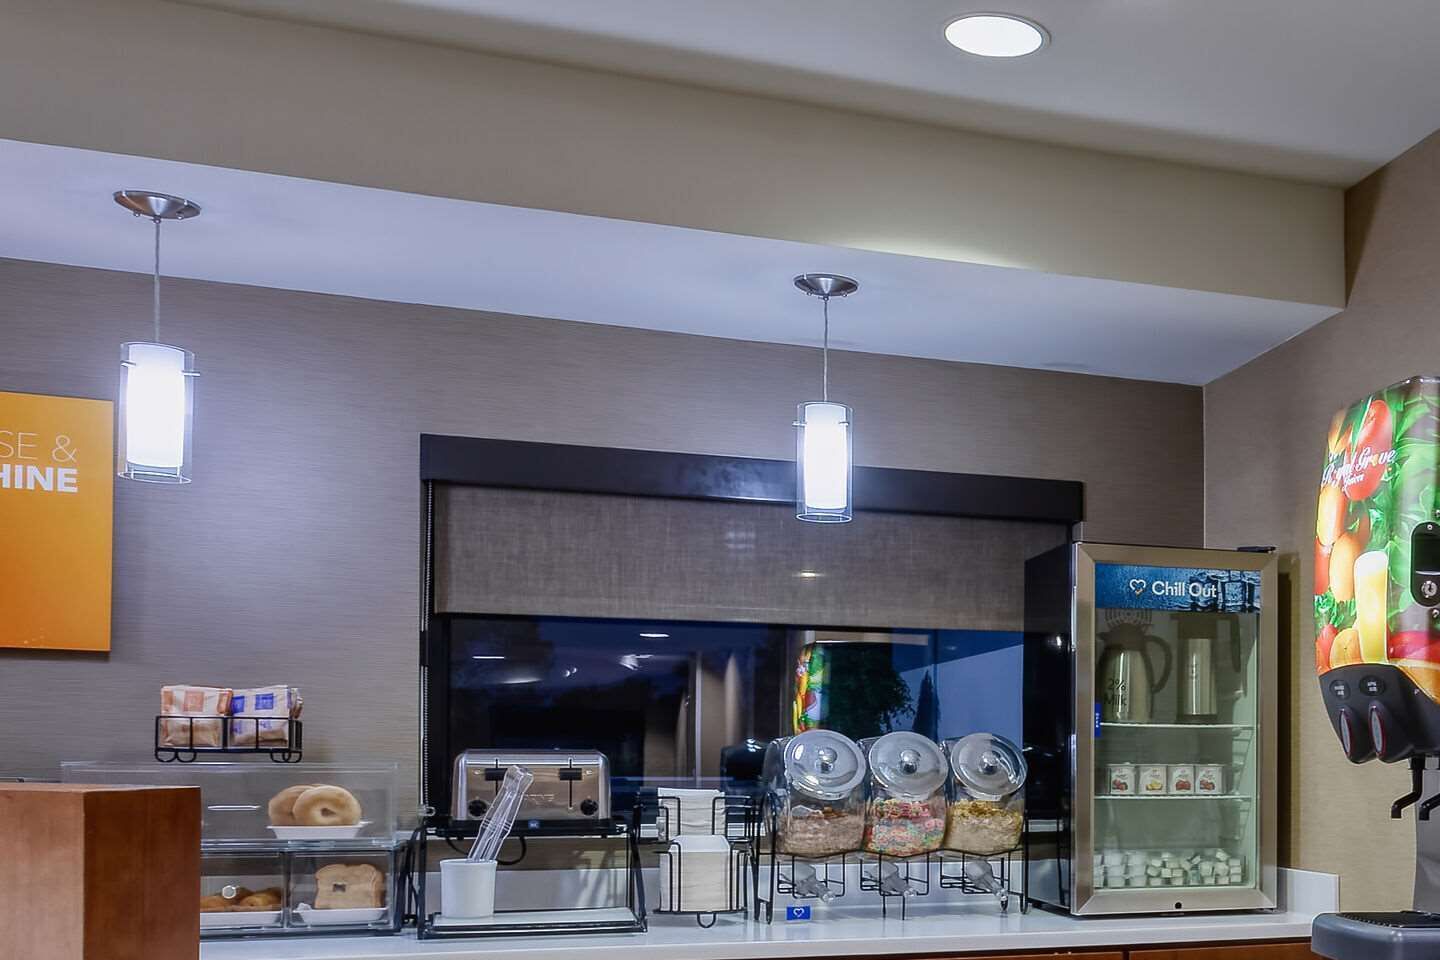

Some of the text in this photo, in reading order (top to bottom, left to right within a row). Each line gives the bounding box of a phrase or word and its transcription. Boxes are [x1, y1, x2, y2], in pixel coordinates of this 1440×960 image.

[51, 434, 78, 463] &
[1152, 580, 1217, 598] Chill Out
[1107, 678, 1127, 691] 2%
